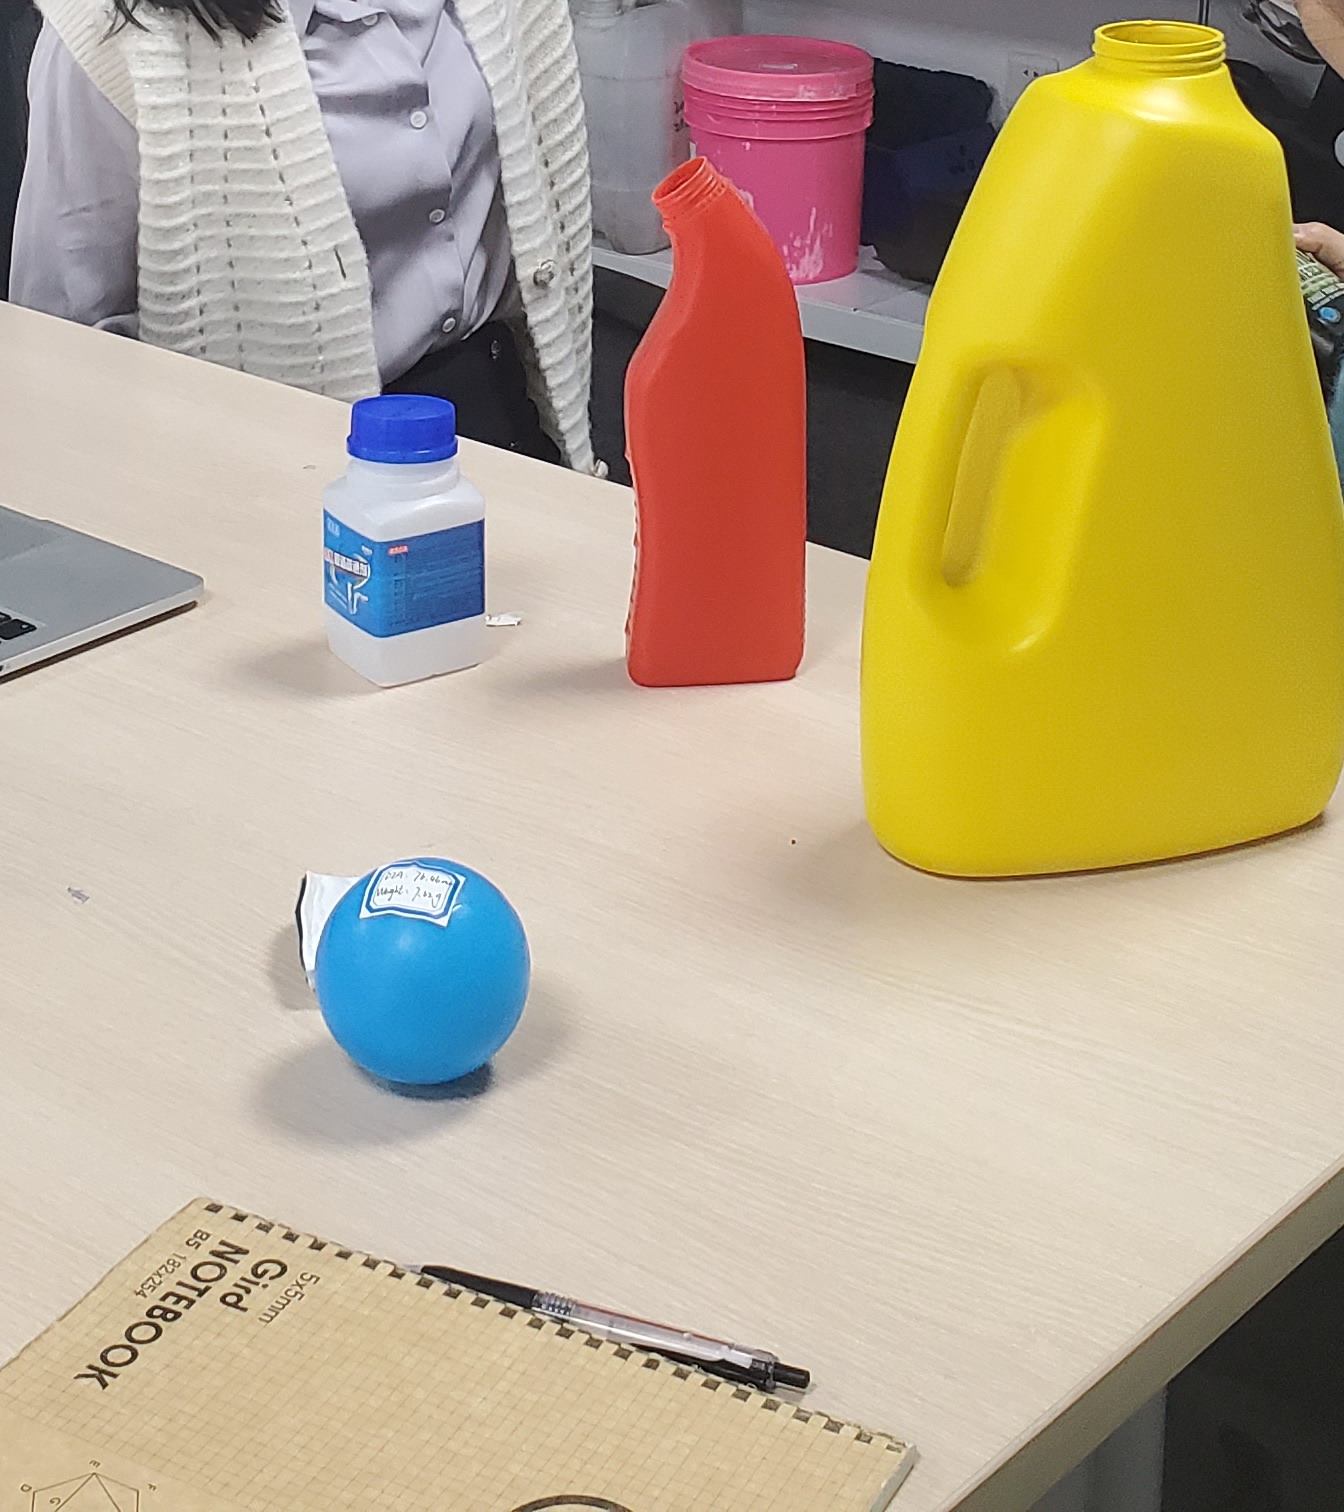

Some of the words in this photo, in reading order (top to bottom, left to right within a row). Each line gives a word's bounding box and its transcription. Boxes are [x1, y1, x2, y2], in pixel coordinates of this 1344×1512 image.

[185, 1229, 212, 1250] B5
[219, 1258, 288, 1313] Gird
[74, 1239, 250, 1390] NOTEBOOK
